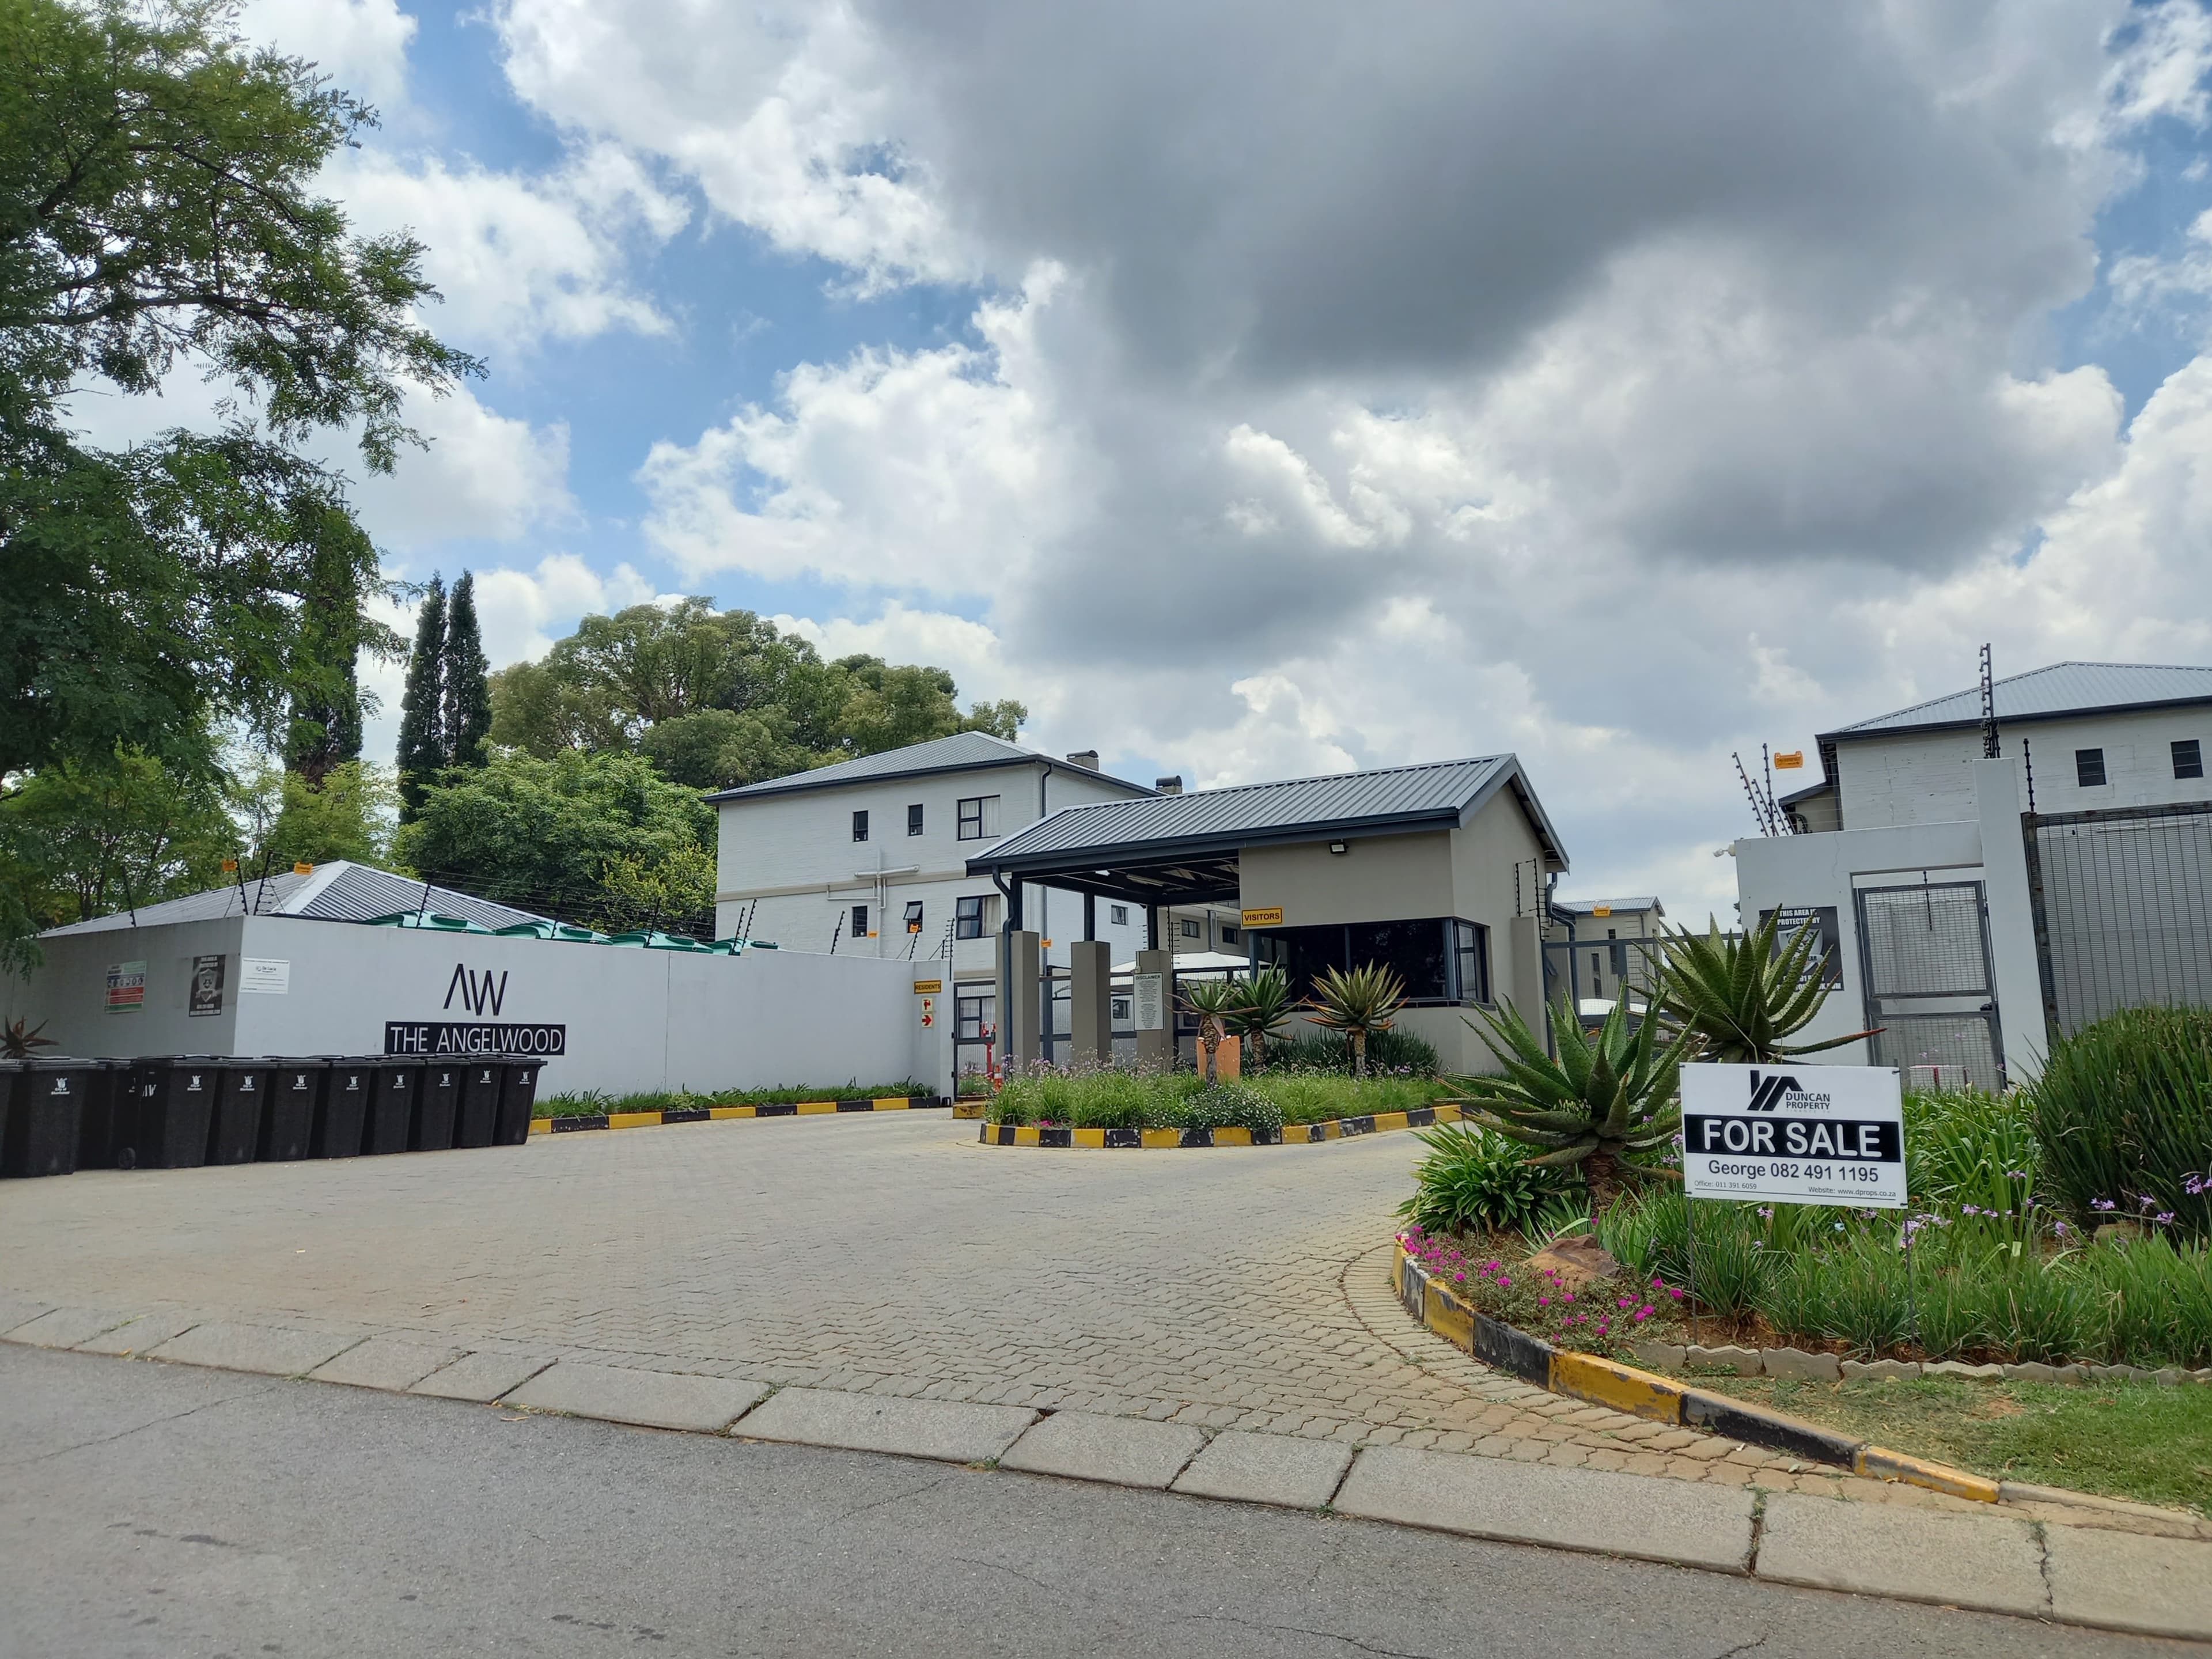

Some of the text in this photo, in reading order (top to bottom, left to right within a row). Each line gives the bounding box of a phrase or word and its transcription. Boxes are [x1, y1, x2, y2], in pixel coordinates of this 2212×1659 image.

[1244, 912, 1280, 921] VISITORS
[390, 1027, 563, 1052] THE ANGELWOOD
[1786, 1092, 1830, 1101] DUNCAN
[1786, 1101, 1830, 1110] PROPERTY
[1703, 1119, 1883, 1157] FOR SALE
[1709, 1160, 1878, 1182] George 082 491 1195
[1808, 1186, 1896, 1198] Website: www.dprops.co.za
